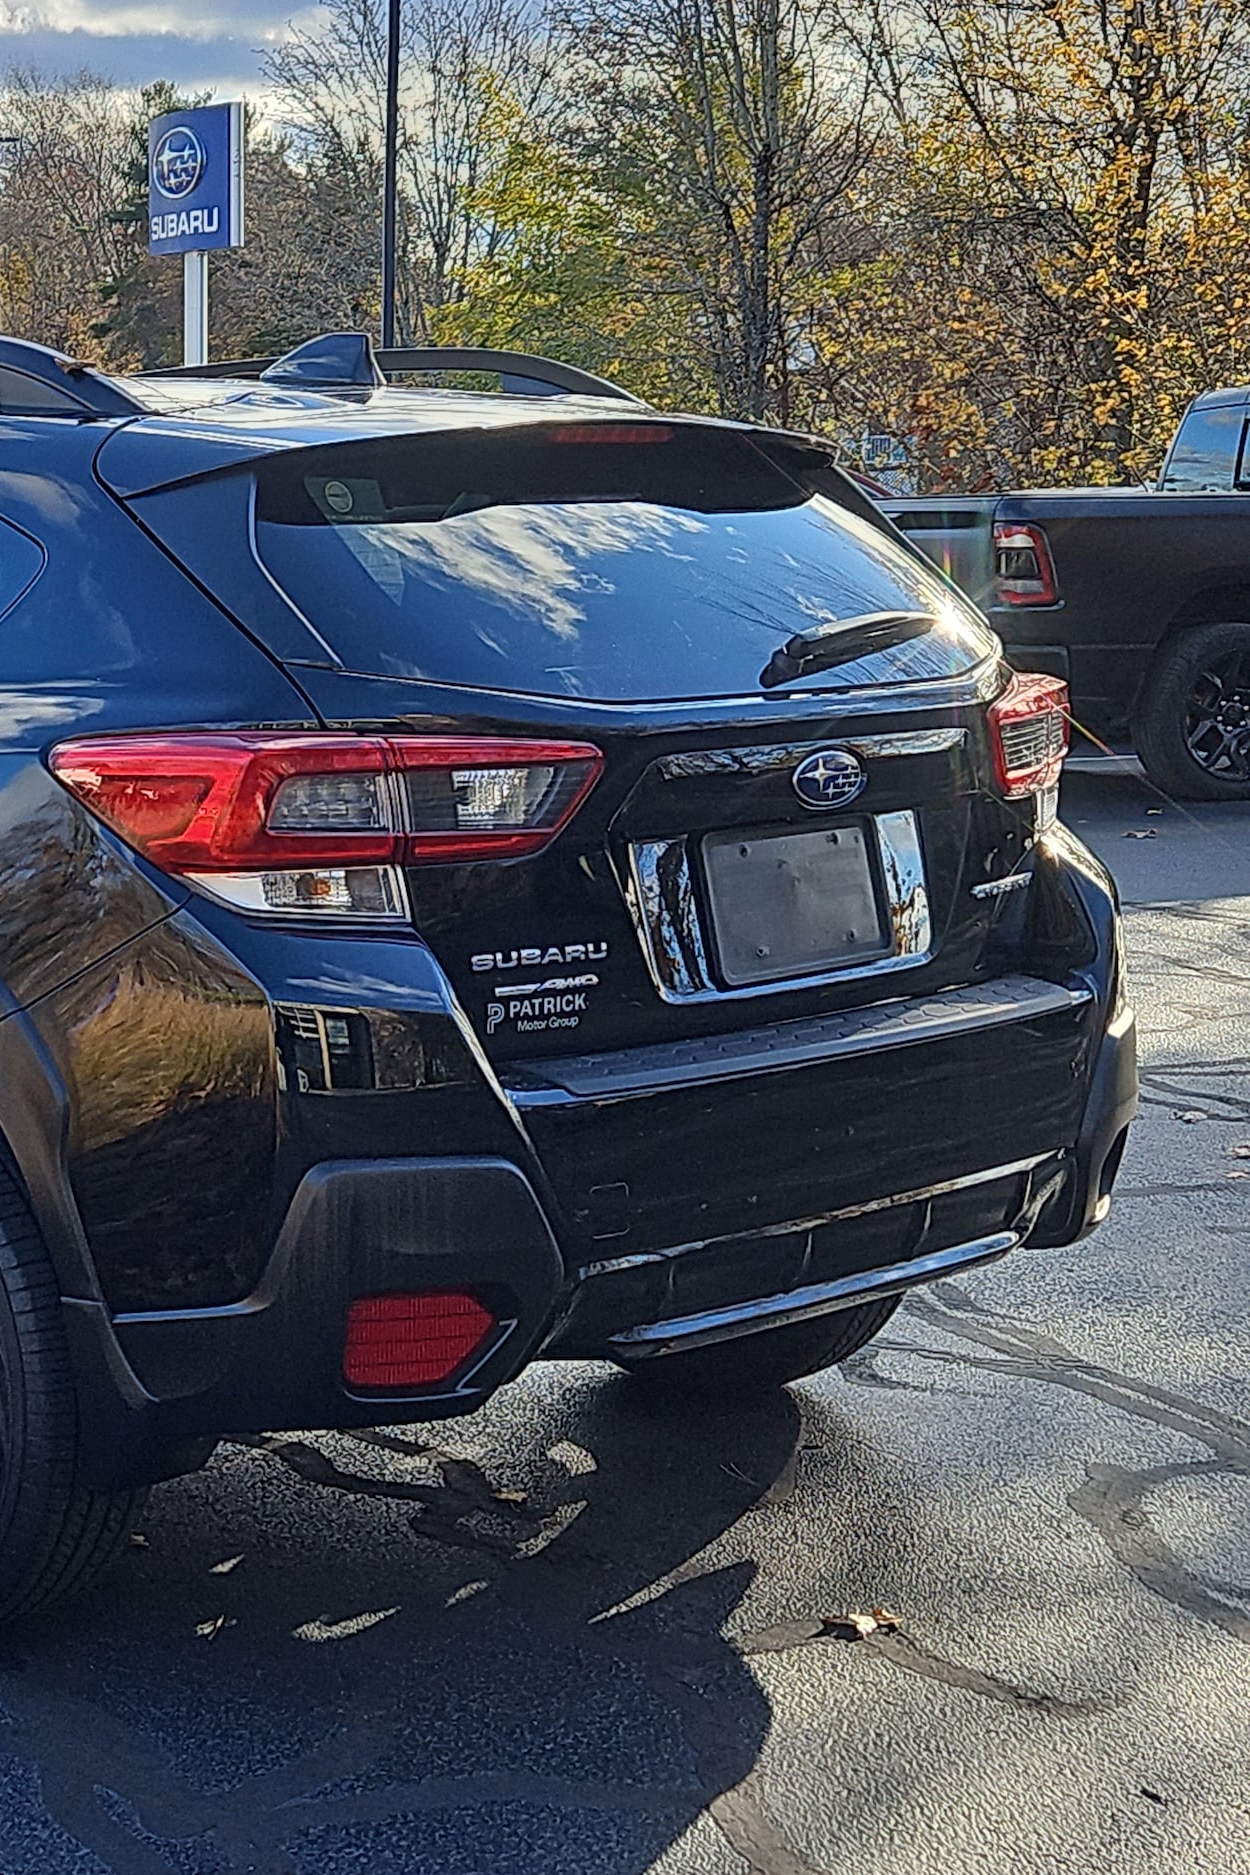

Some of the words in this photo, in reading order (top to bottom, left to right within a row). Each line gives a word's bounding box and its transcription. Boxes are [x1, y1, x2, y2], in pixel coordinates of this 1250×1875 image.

[151, 206, 219, 241] SUBARU
[470, 942, 608, 972] SUBARU
[509, 992, 588, 1019] PATRICK
[517, 1019, 548, 1032] Motor
[548, 1015, 579, 1029] Group
